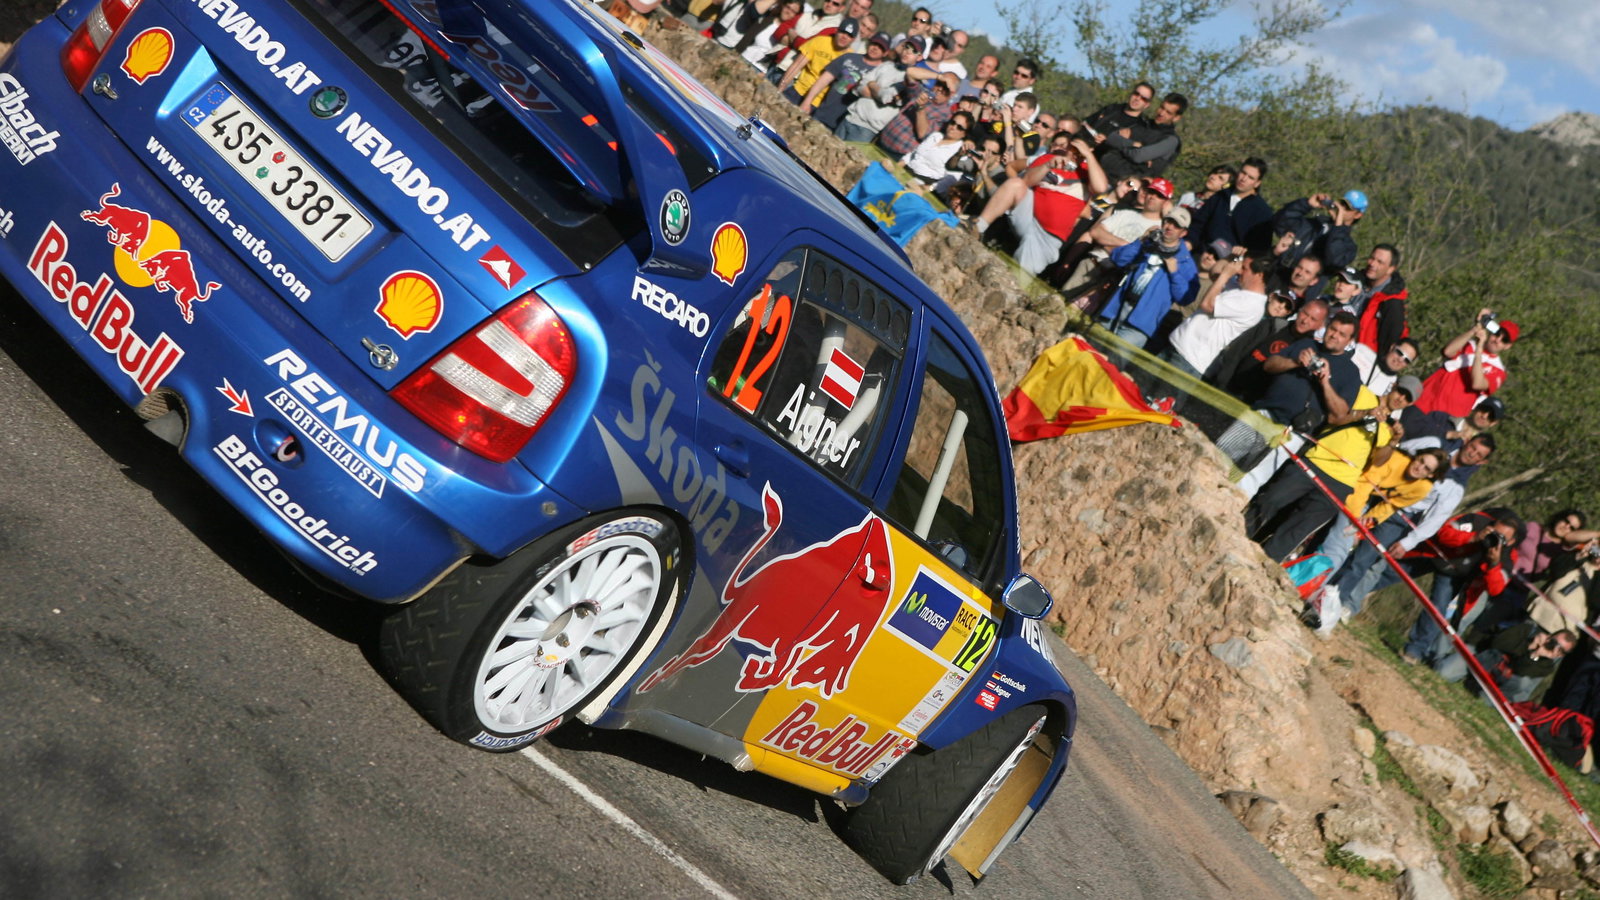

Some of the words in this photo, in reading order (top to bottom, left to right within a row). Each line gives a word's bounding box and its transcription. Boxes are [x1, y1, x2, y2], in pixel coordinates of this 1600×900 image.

[189, 107, 206, 122] CZ
[146, 136, 312, 302] www.skoda-auto.com
[211, 110, 273, 165] 4S5
[271, 166, 352, 243] 3381
[336, 112, 491, 251] NEVADO.AT
[631, 275, 710, 338] RECARO
[723, 283, 793, 414] 12
[264, 348, 428, 493] REMUS
[274, 393, 381, 489] SPORTEXHAUST
[776, 383, 861, 469] Aigner
[218, 434, 378, 572] BFGoodrich
[955, 618, 996, 671] 12
[956, 608, 977, 630] RACC
[994, 685, 1012, 698] Aigner
